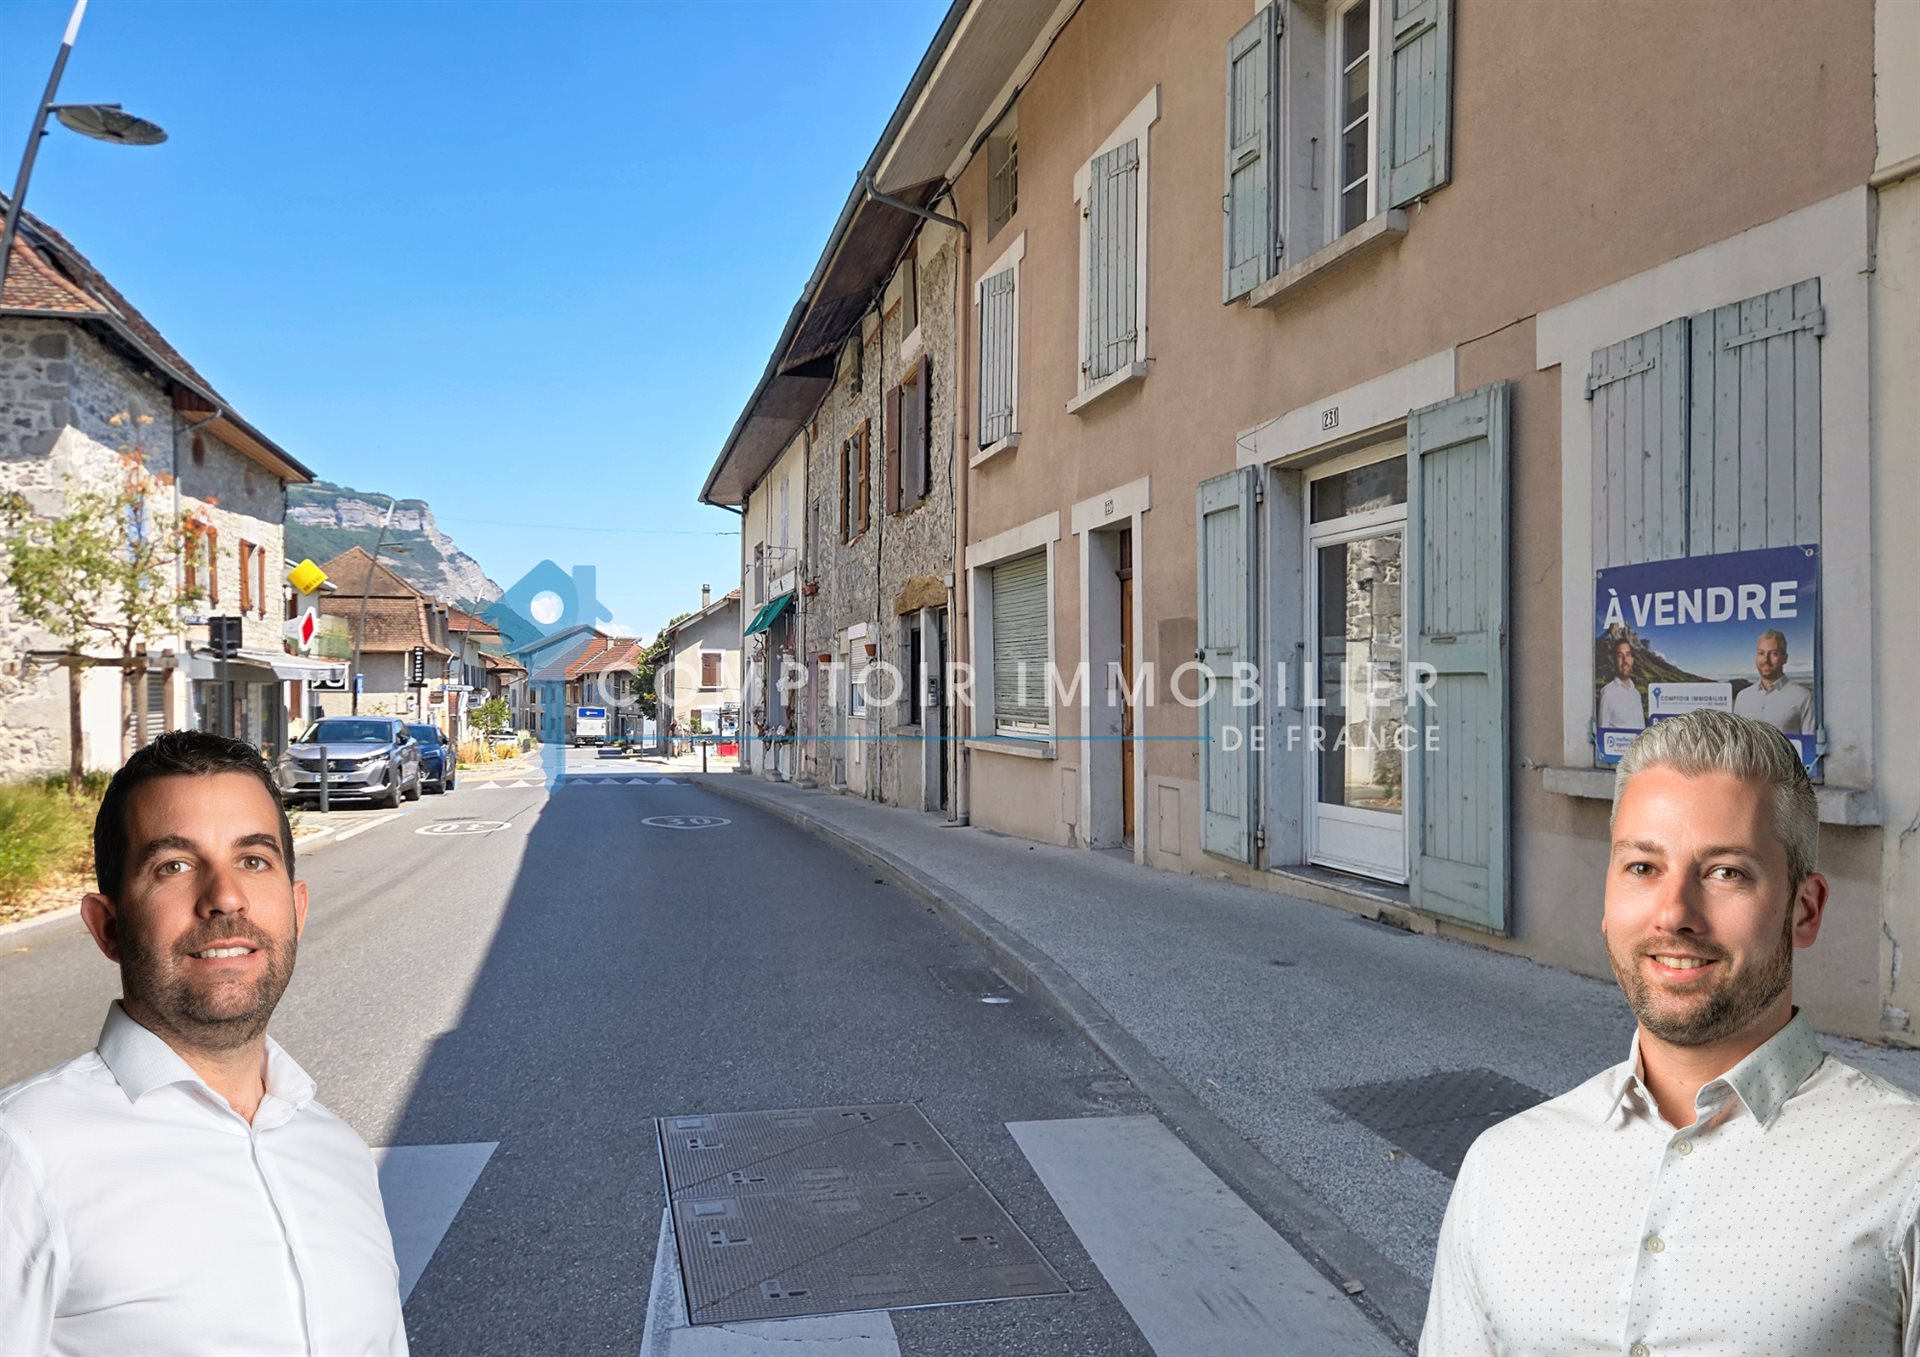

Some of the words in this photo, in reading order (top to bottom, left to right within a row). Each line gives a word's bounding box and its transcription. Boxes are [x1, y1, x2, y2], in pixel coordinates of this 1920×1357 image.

[1324, 410, 1337, 427] 231
[1603, 588, 1625, 630] À
[1630, 580, 1798, 628] VENDRE
